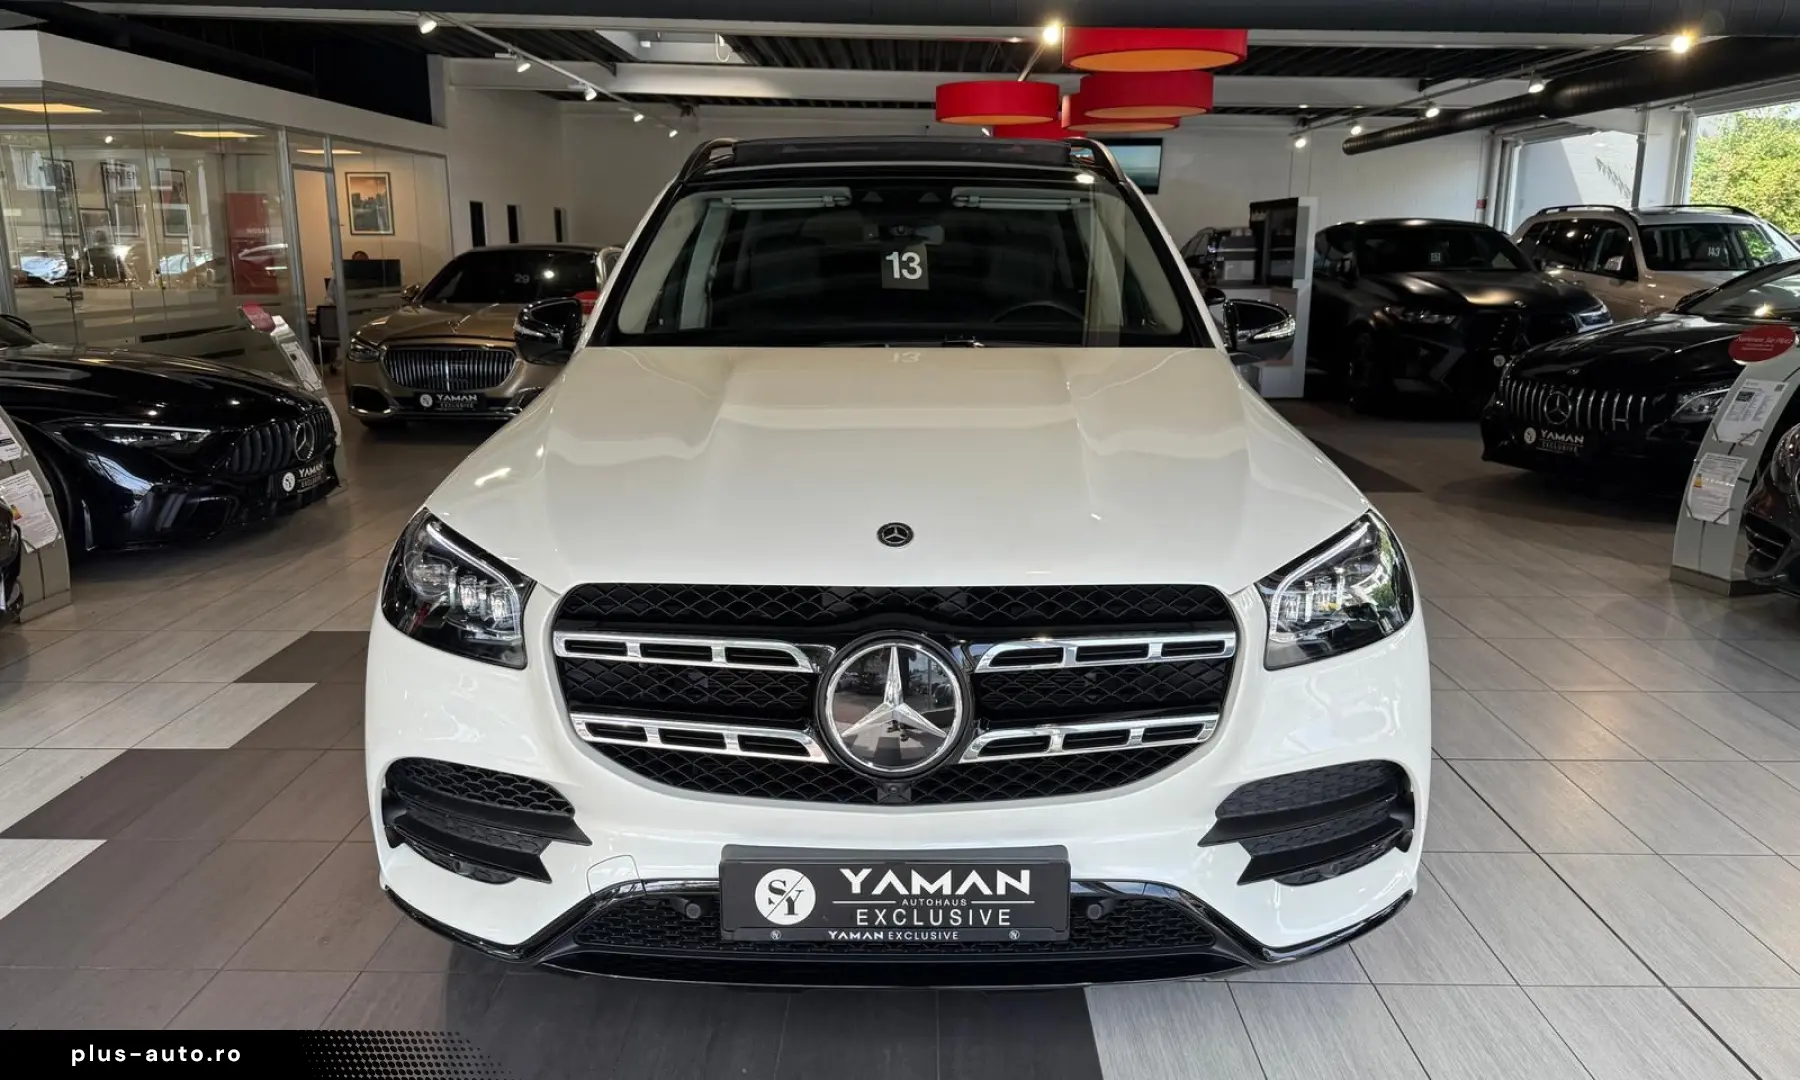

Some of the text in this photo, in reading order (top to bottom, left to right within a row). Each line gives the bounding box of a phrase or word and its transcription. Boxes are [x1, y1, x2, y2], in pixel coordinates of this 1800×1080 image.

[886, 252, 922, 279] 13
[436, 394, 478, 402] YAMAN
[1540, 429, 1585, 444] YAMAN
[839, 868, 1030, 895] YAMAN
[902, 898, 967, 906] AUTOHAUS
[856, 908, 1011, 926] EXCLUSIVE
[828, 930, 959, 940] YAMAN EXCLUSIVE
